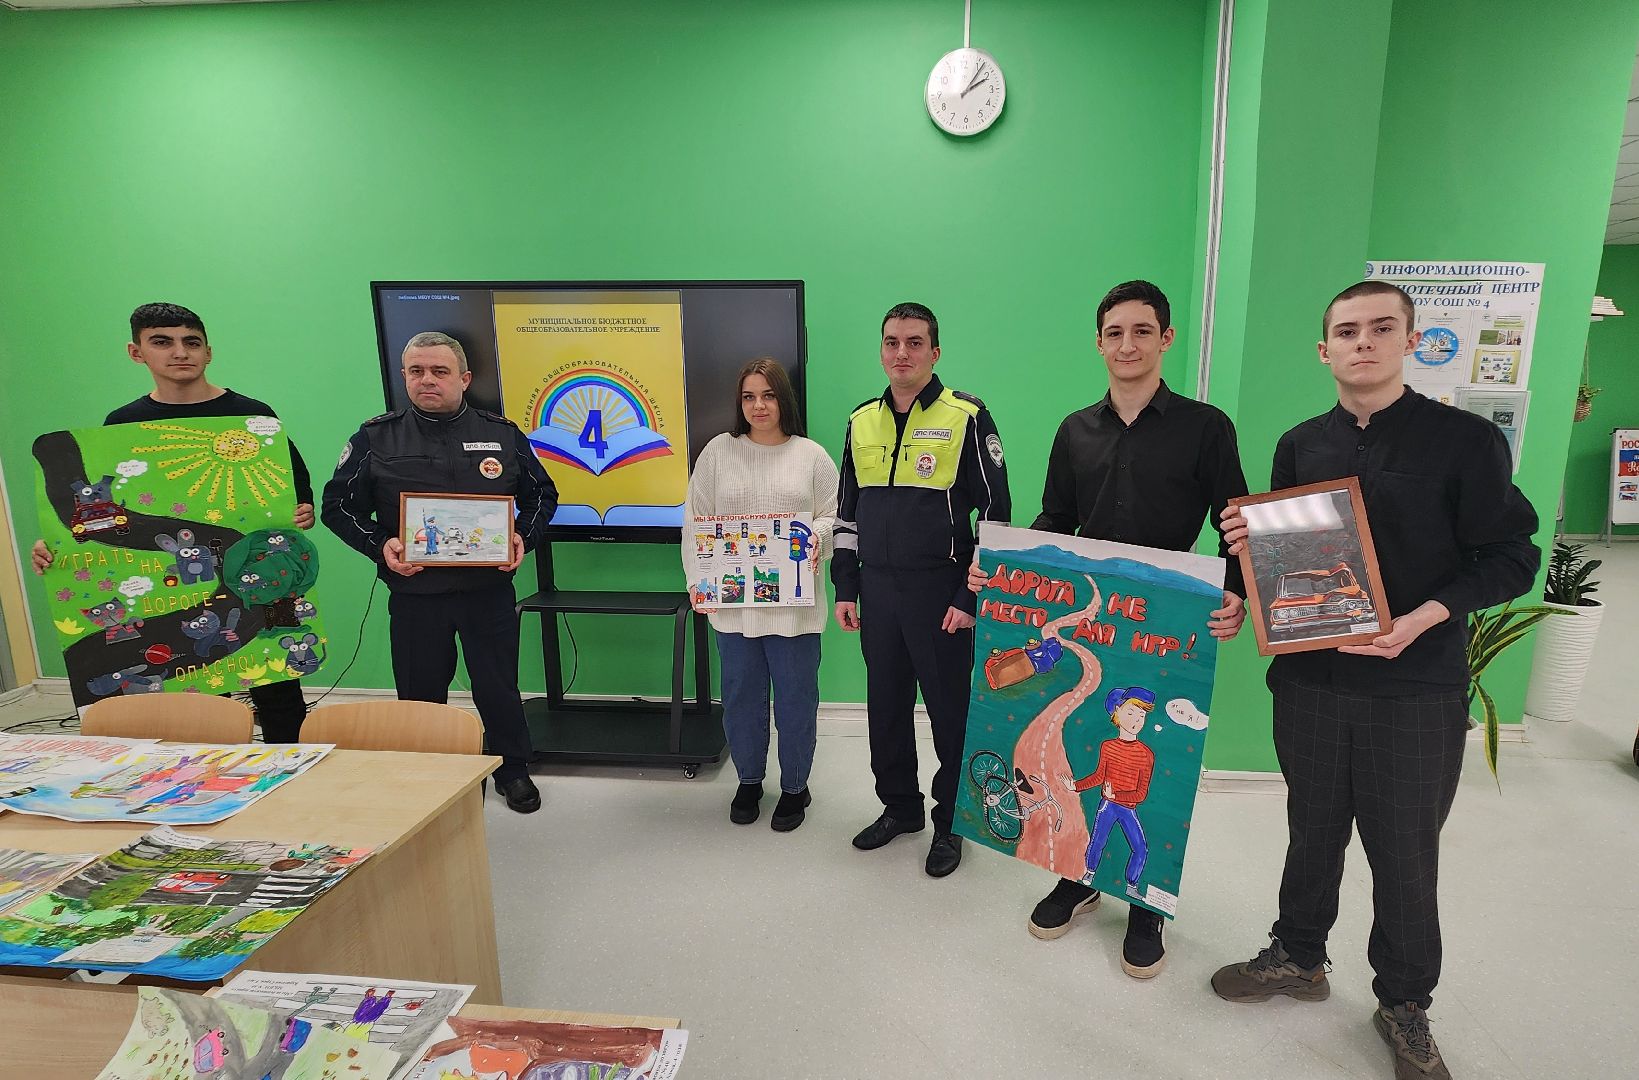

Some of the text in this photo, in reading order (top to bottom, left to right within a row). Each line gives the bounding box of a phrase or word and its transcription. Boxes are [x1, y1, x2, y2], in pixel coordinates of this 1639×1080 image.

[984, 72, 989, 80] 2
[964, 115, 968, 123] 6
[1380, 264, 1530, 276] ИНФОРМАЦИОННО-
[1434, 298, 1464, 306] СОШ
[1492, 283, 1540, 295] ЦЕНТР
[524, 360, 664, 428] СРЕДНЯЯ ОБЩЕОБРАЗОВАТЕЛЬНАЯ ШКОЛА
[578, 409, 608, 458] 4
[58, 548, 163, 575] ИГРАТЬ НА
[987, 563, 1148, 621] ДОРОГА НЕ
[980, 599, 1048, 628] МЕСТО
[1072, 617, 1116, 646] ДЛЯ
[175, 654, 255, 681] ОПАСНО!
